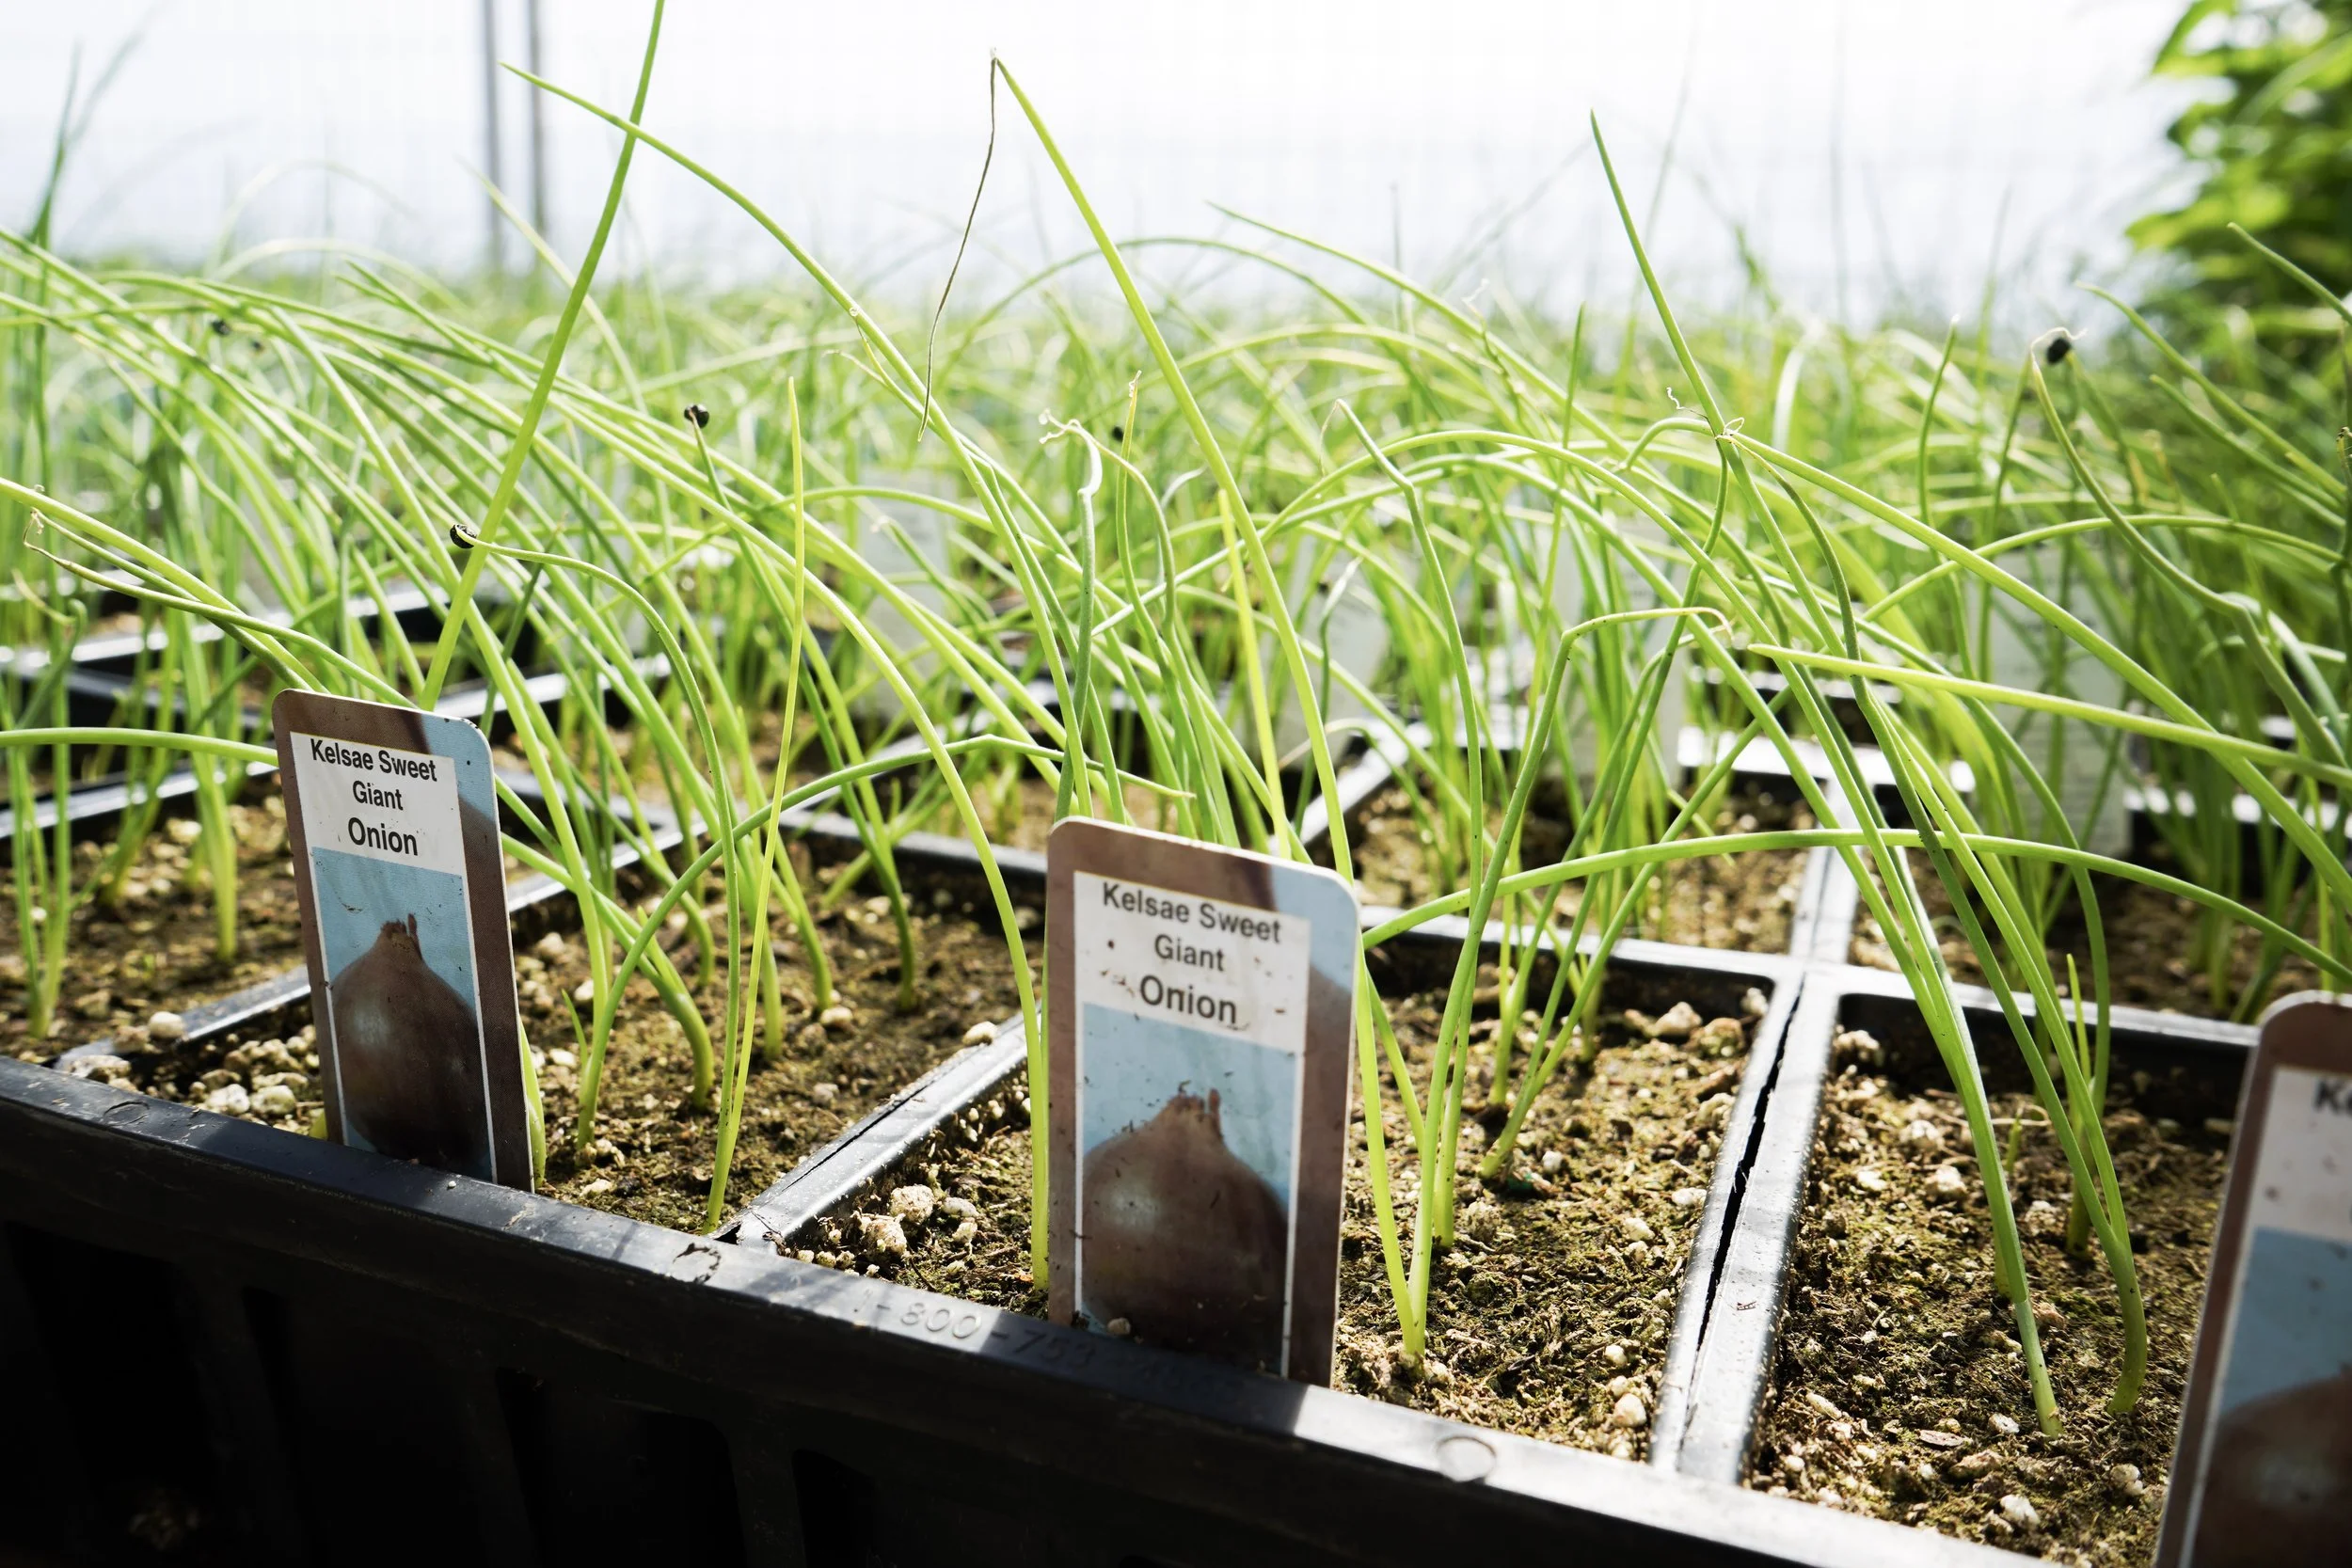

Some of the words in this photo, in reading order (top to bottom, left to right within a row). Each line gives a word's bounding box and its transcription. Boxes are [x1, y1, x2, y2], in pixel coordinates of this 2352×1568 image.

[310, 738, 373, 769] Kelsae
[378, 750, 437, 782] Sweet
[353, 781, 404, 810] Giant
[348, 817, 418, 856] Onion
[1103, 882, 1189, 924] Kelsae
[1200, 903, 1281, 943] Sweet
[1154, 934, 1224, 971] Giant
[1139, 974, 1236, 1024] Onion
